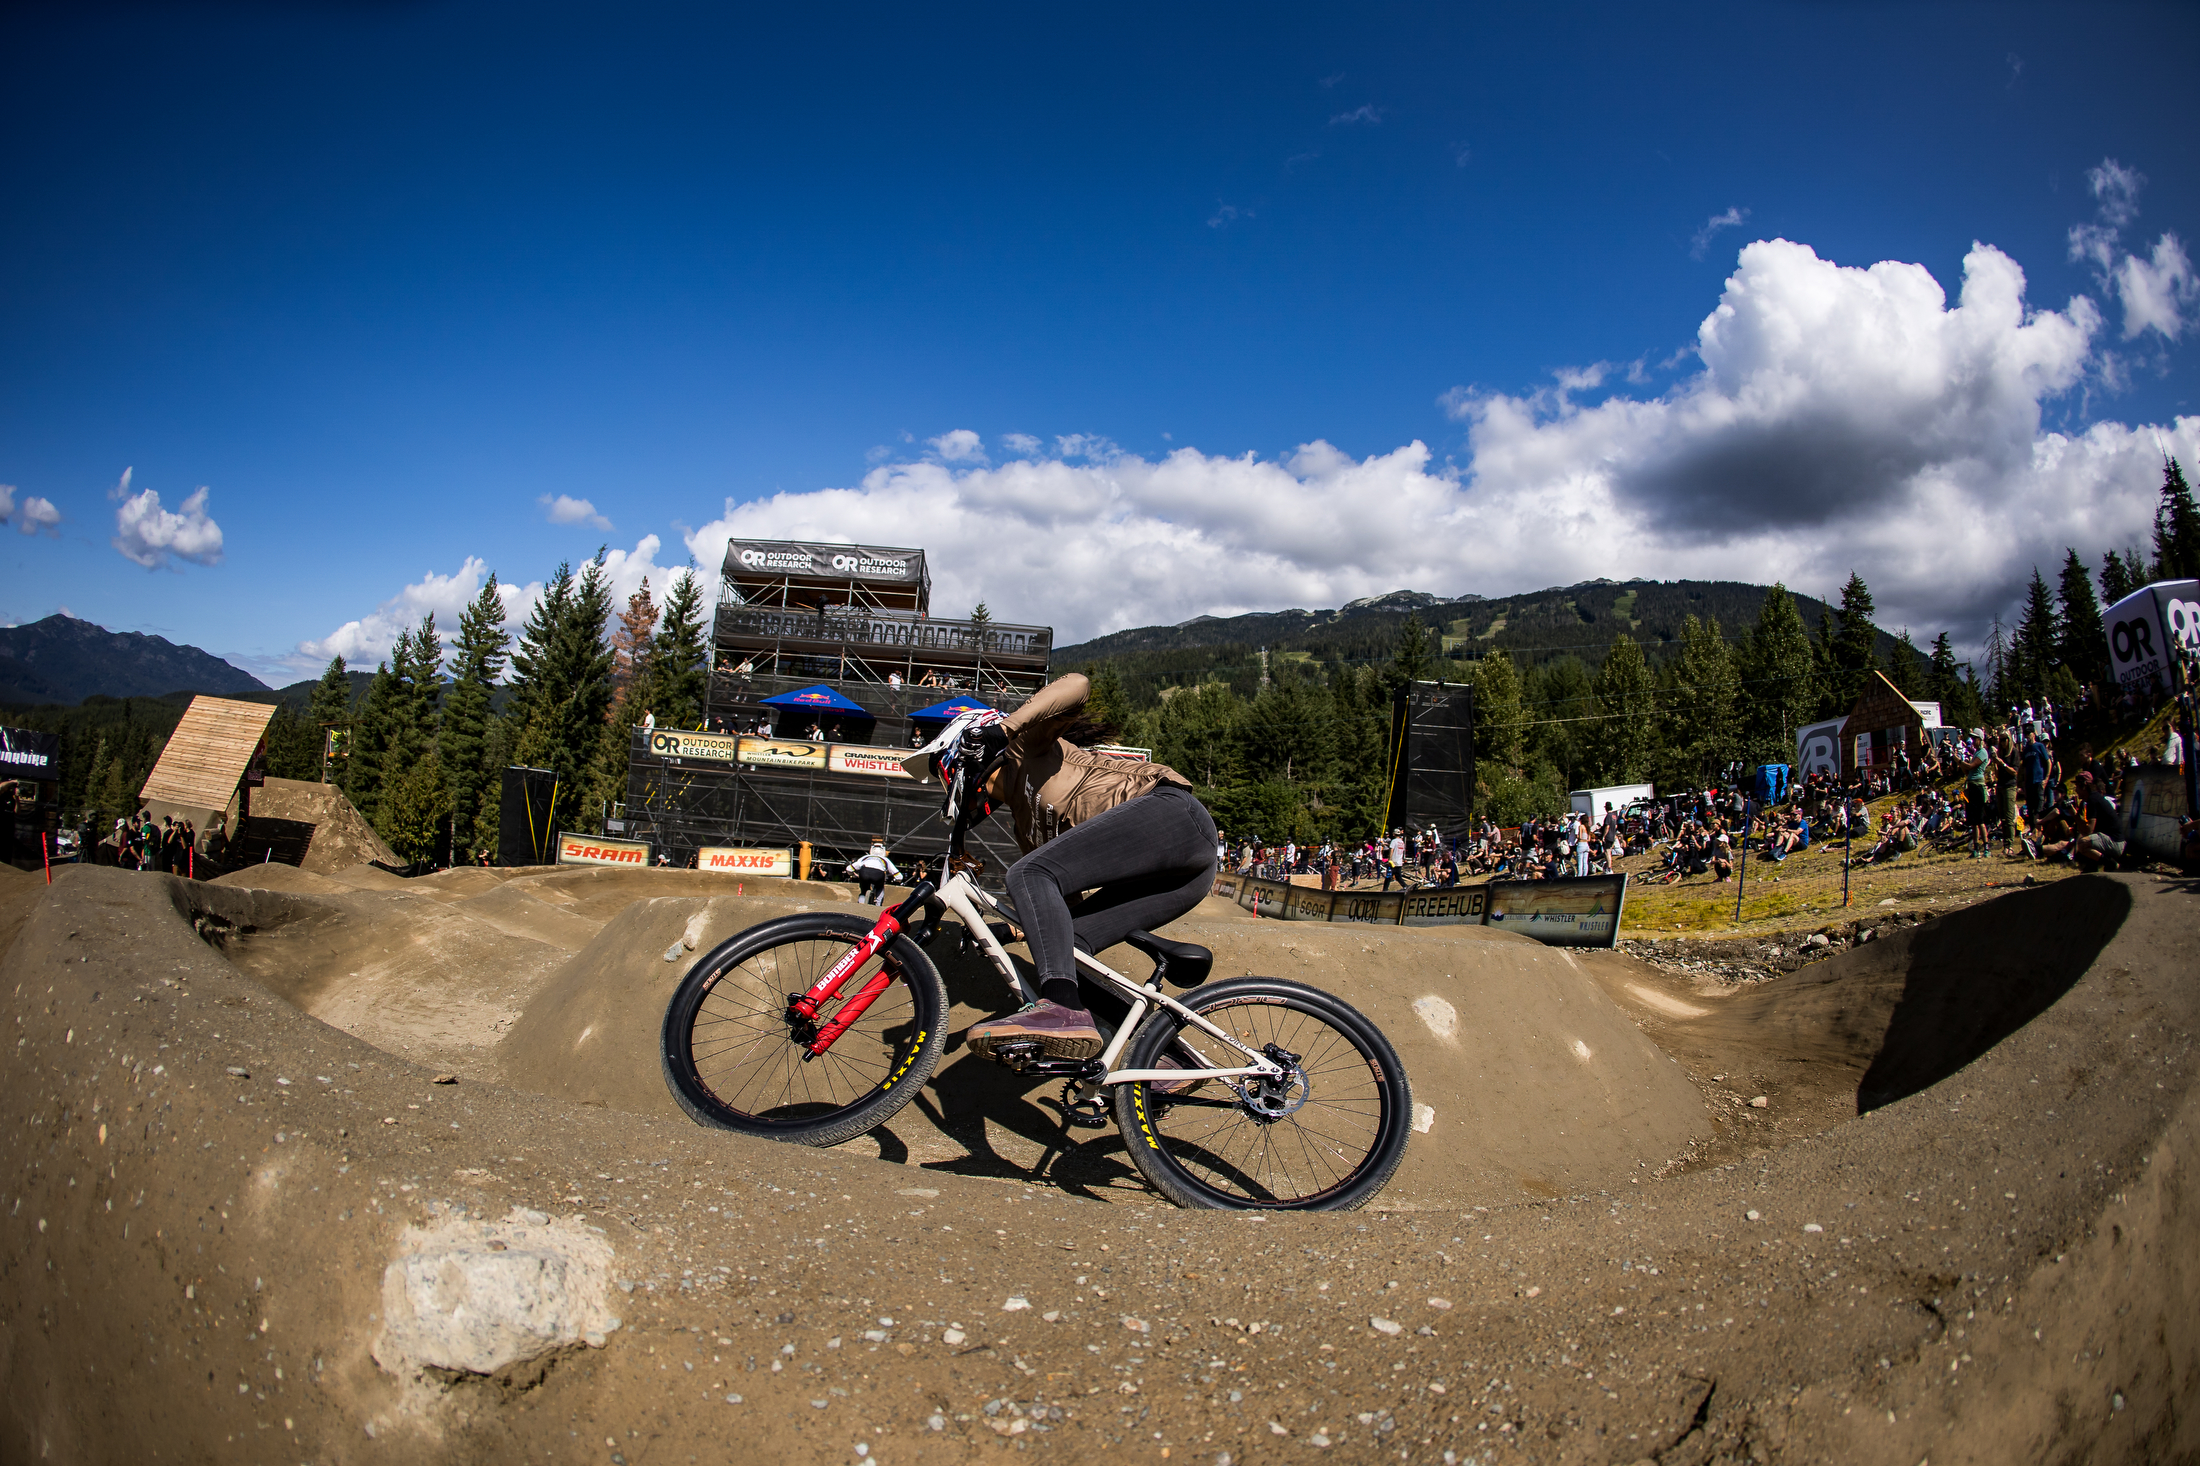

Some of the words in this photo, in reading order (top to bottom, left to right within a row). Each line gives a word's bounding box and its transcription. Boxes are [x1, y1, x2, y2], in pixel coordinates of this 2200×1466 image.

[740, 549, 767, 567] OR
[766, 559, 812, 569] RESEARCH
[767, 552, 812, 562] OUTDOOR
[831, 554, 859, 573] OR
[859, 557, 907, 568] OUTDOOR
[859, 565, 906, 575] RESEARCH
[2111, 617, 2157, 663] OR
[2120, 659, 2160, 684] OUTDOOR
[653, 733, 681, 754] OR
[682, 738, 733, 750] OUTDOOR
[682, 747, 732, 759] RESEARCH
[565, 844, 642, 863] SRAM
[710, 854, 774, 868] MAXXIS
[1300, 901, 1325, 919] SCOR
[1406, 893, 1484, 918] FREEHUB
[1544, 914, 1576, 923] WHISTLER
[1578, 921, 1609, 931] WHISTLER
[816, 947, 860, 992] BOMBER
[883, 1030, 927, 1091] MAXXIS
